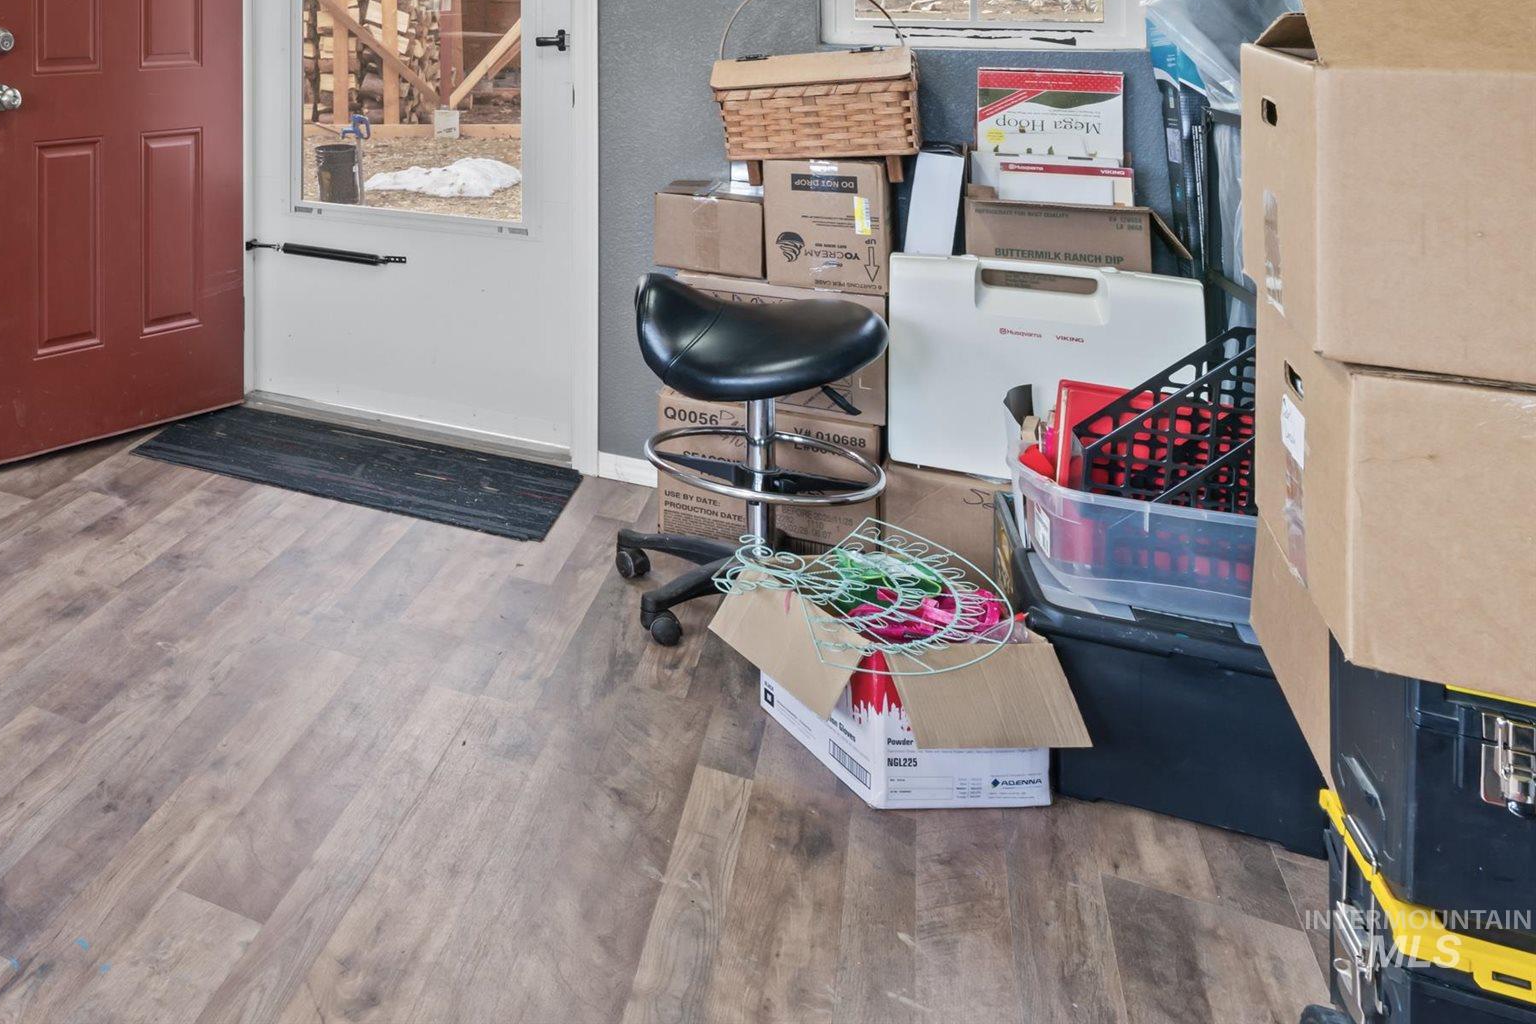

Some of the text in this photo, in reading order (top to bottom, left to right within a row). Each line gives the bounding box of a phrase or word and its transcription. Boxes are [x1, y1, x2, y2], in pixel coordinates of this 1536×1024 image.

[996, 115, 1101, 135] Mega Hoop
[794, 178, 818, 187] DROP
[819, 179, 839, 188] NOT
[805, 249, 860, 260] YOCREAM
[995, 247, 1124, 265] BUTTERMILK RANCH DIP
[846, 282, 877, 290] CARTONS
[1056, 335, 1084, 343] VIKING
[664, 406, 719, 425] Q0056
[664, 489, 680, 498] USE
[696, 496, 720, 507] DATE:
[664, 500, 718, 517] PRODUCTION
[887, 738, 914, 746] Powder
[887, 757, 918, 767] NGL225
[1001, 778, 1042, 786] ADENNA
